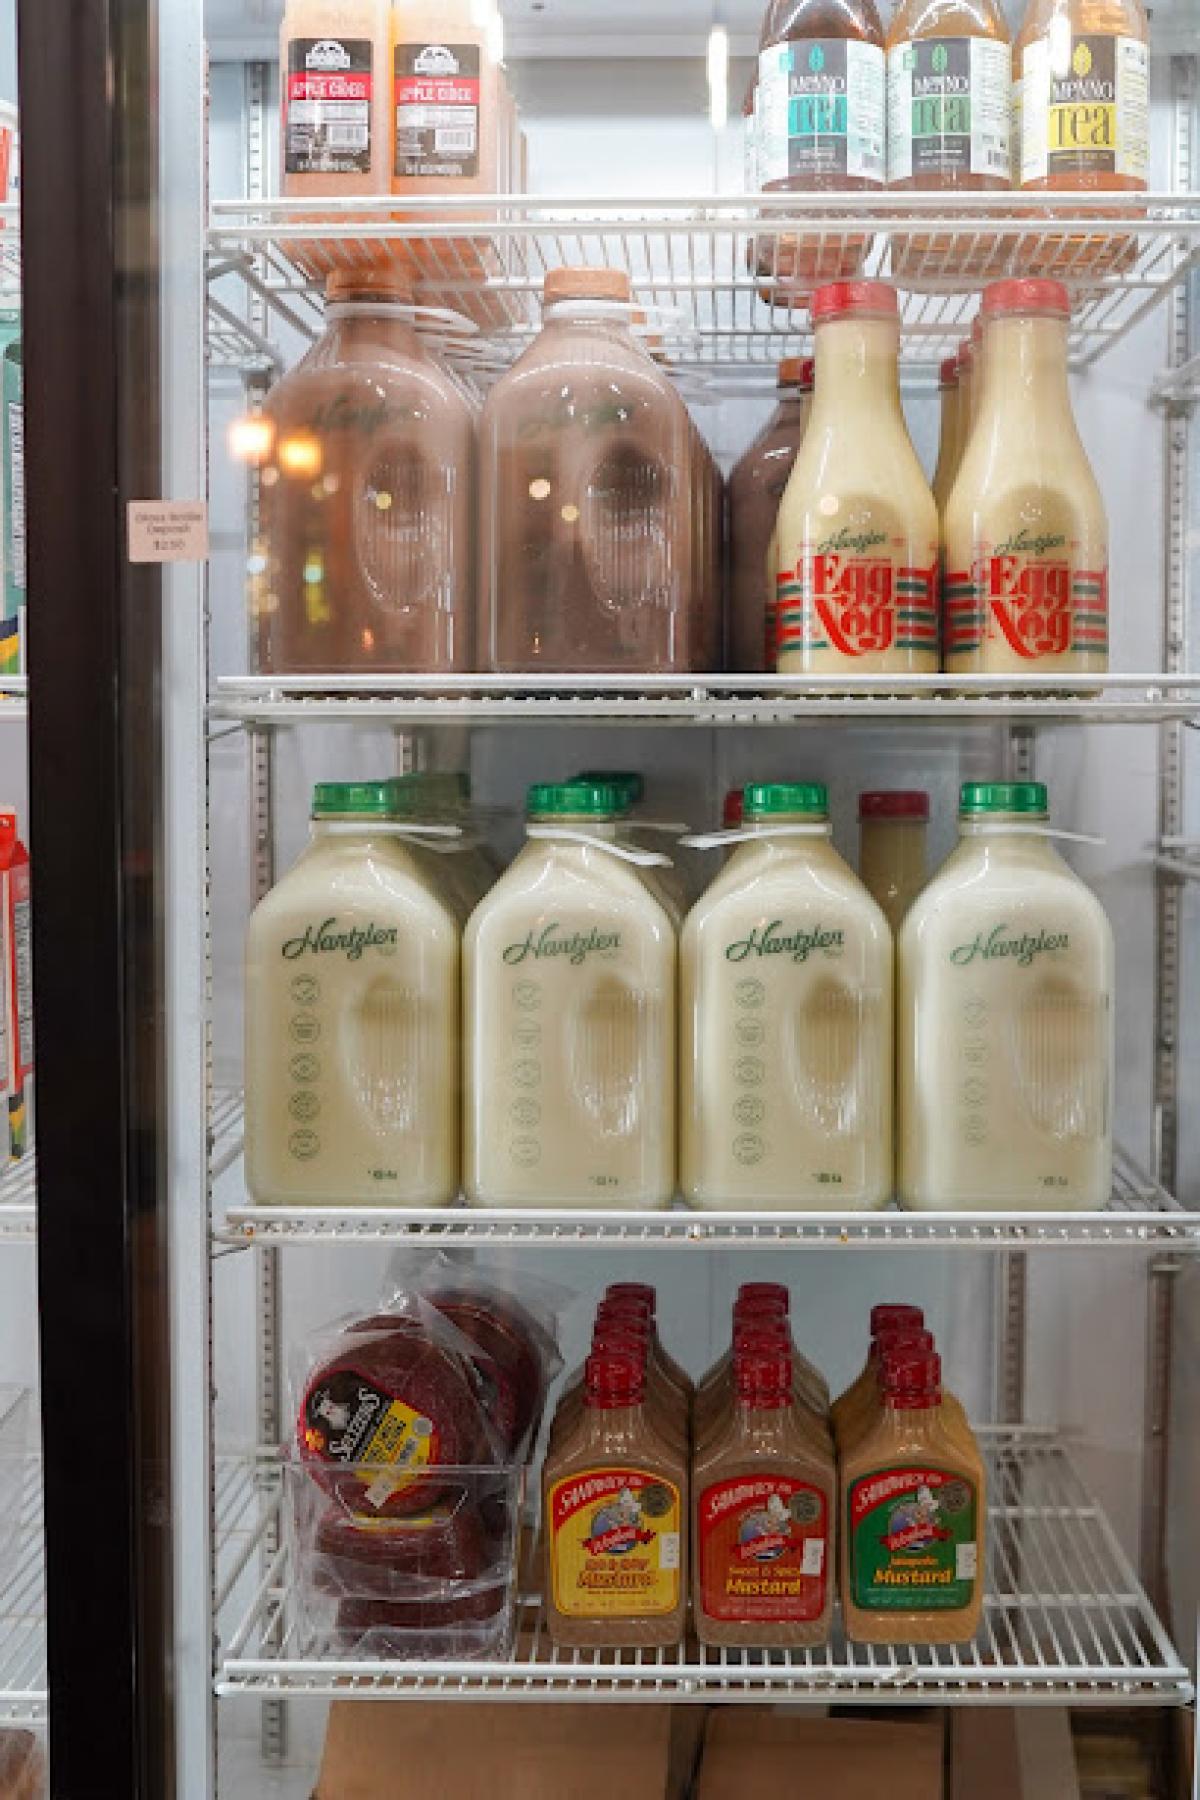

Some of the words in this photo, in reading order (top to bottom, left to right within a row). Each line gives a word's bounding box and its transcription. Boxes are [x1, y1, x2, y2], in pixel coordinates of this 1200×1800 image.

[797, 554, 893, 606] Egg
[971, 555, 1070, 610] Egg
[811, 597, 894, 657] Nog
[986, 599, 1072, 660] Nog
[725, 1578, 801, 1595] Mustard
[872, 1567, 954, 1585] Mustard
